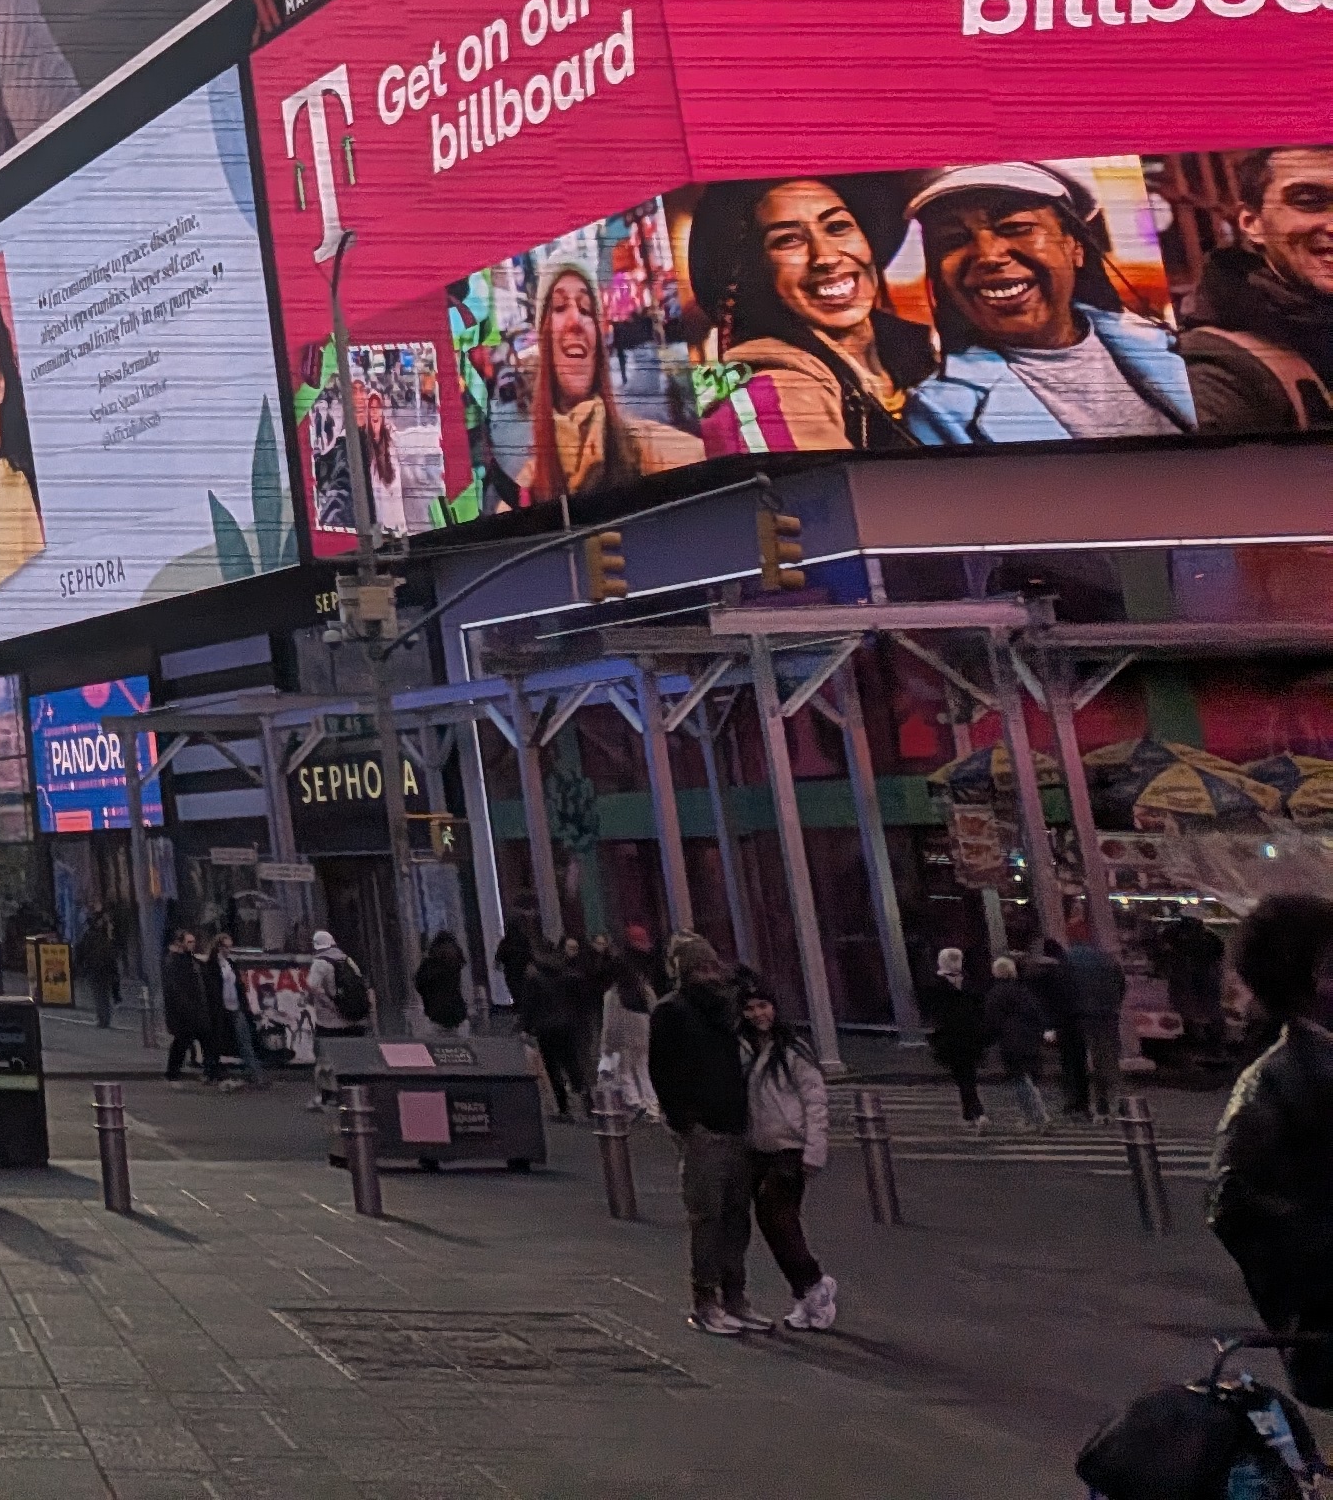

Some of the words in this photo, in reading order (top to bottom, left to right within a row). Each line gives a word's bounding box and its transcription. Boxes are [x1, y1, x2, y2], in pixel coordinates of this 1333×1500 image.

[377, 40, 447, 125] Get
[457, 19, 509, 82] on
[431, 9, 635, 174] billboard
[59, 556, 126, 598] SEPHORA
[299, 759, 418, 803] SEPHOA
